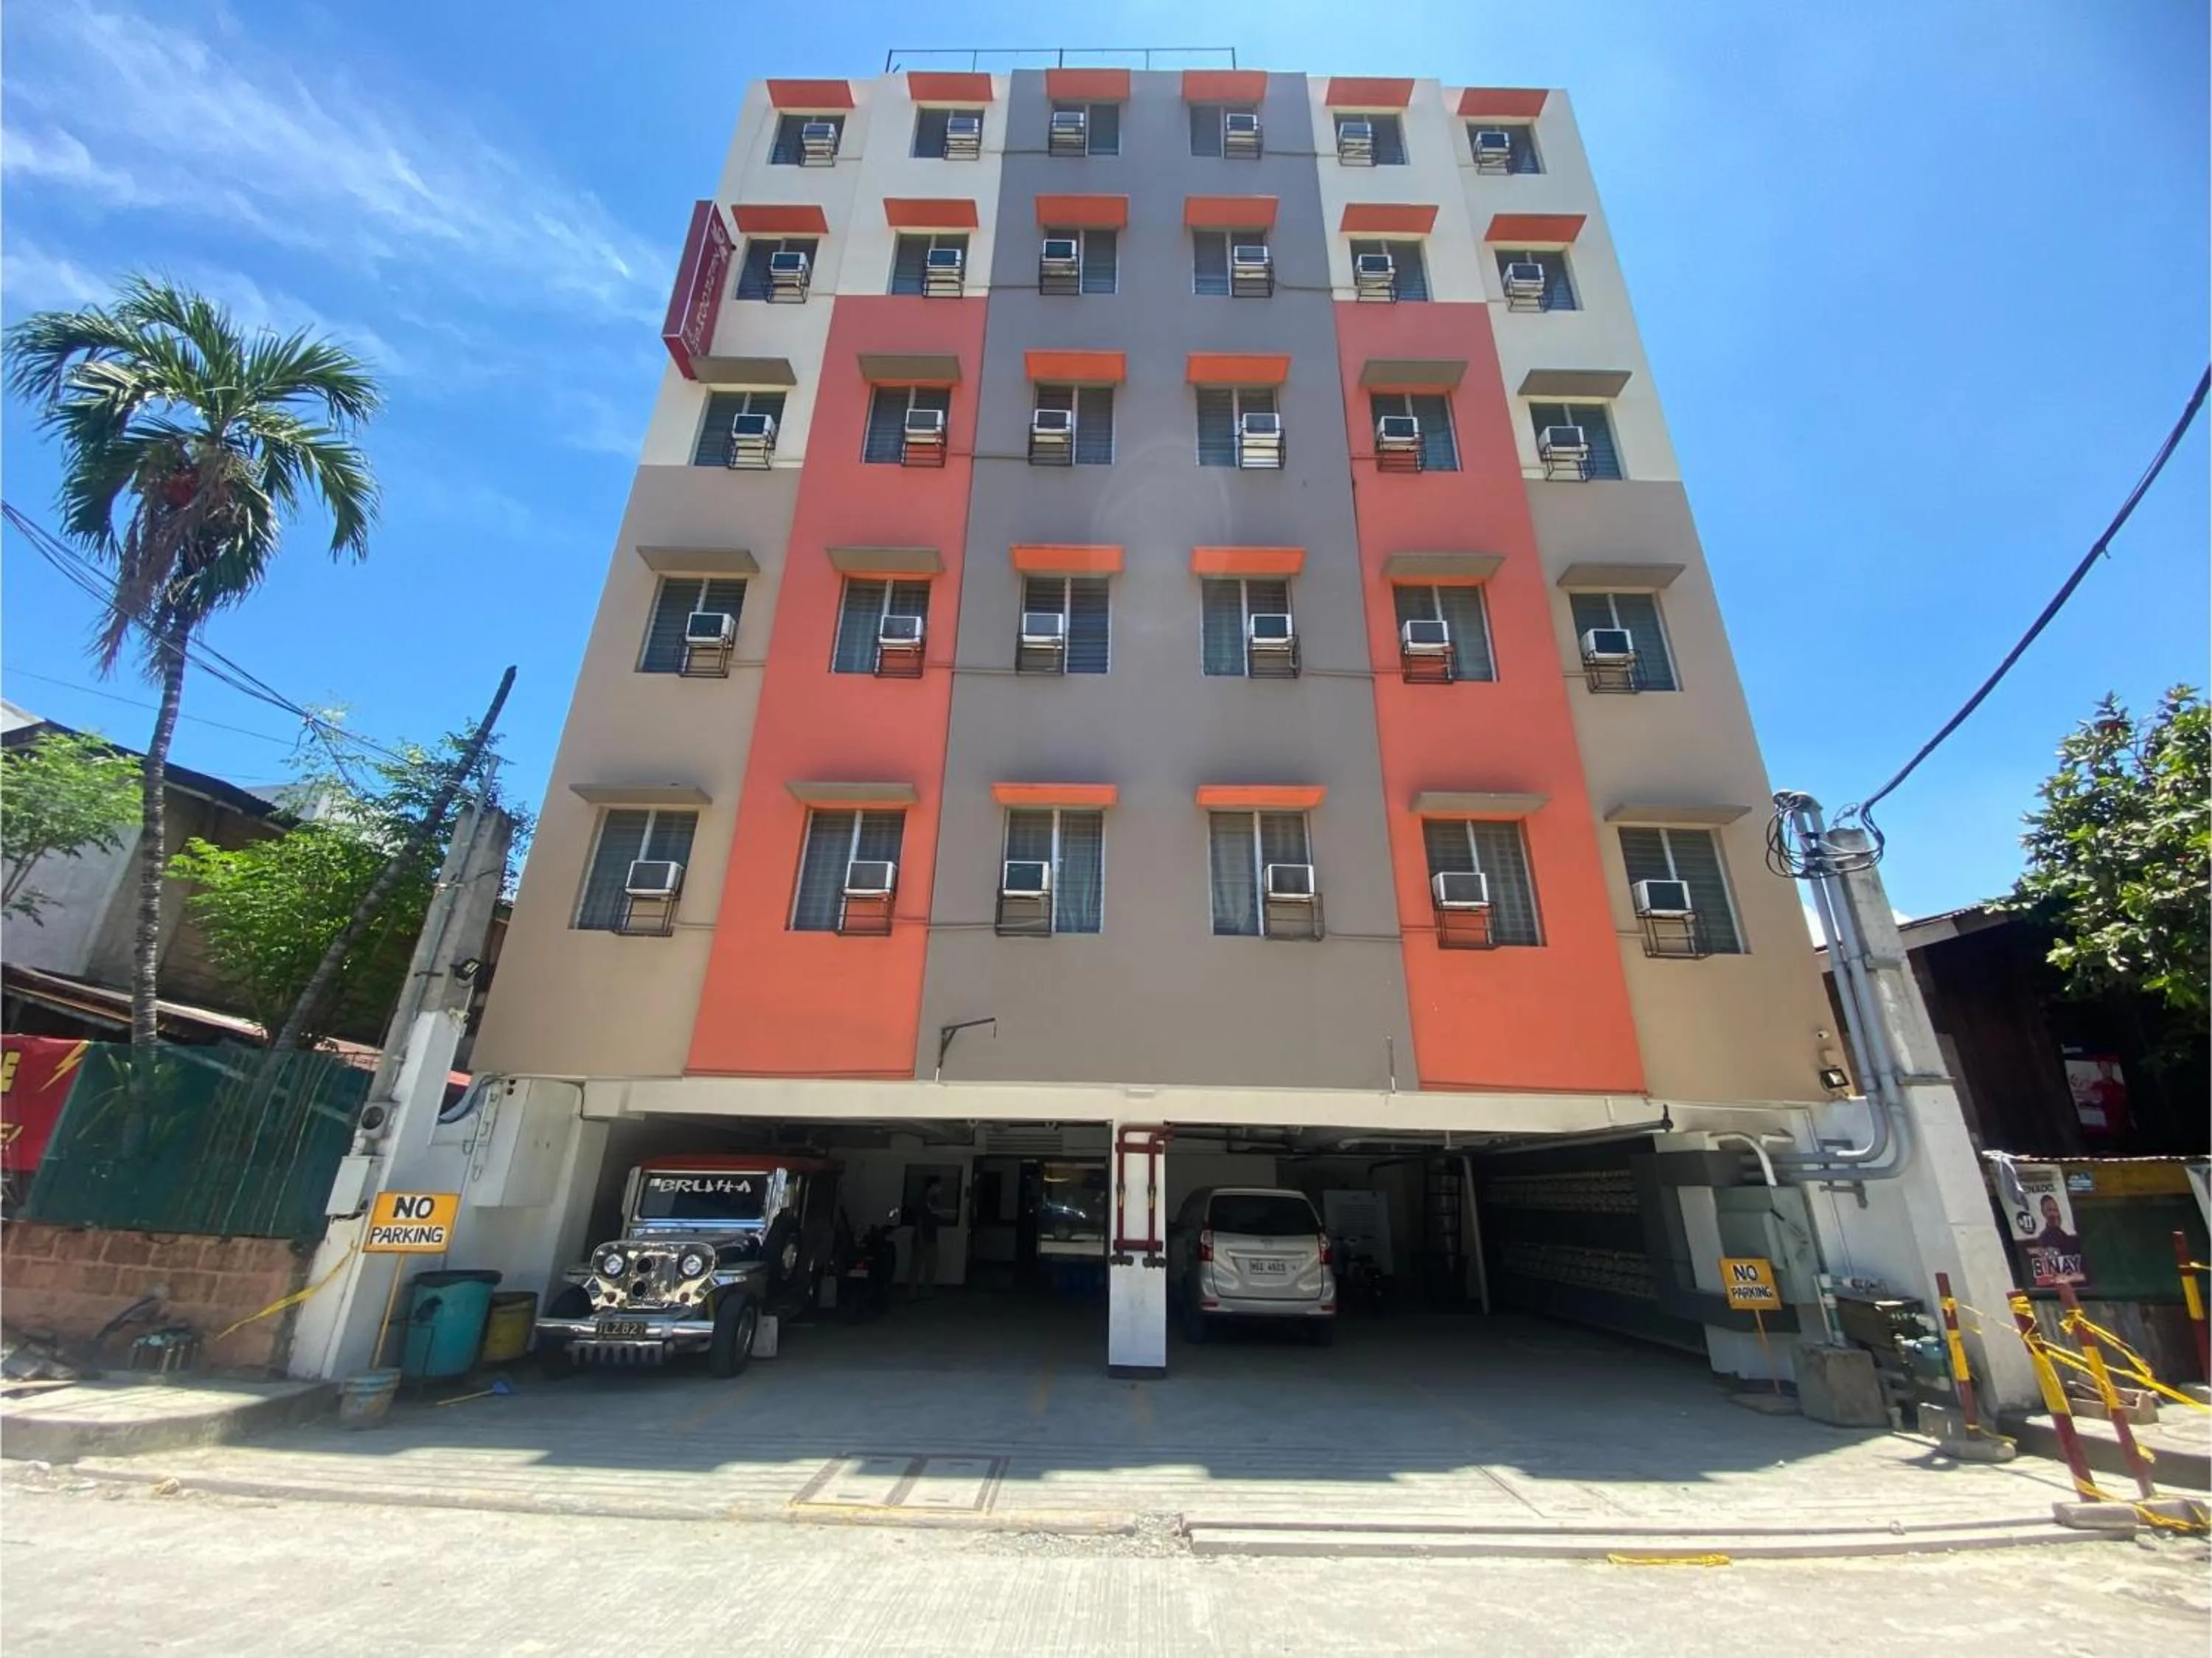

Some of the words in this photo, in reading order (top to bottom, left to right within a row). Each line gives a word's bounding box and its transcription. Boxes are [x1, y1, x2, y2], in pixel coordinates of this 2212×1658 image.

[393, 1196, 435, 1218] NO
[369, 1227, 444, 1245] PARKING
[1733, 1264, 1758, 1281] NO
[2032, 1254, 2081, 1277] BINAY
[1731, 1286, 1773, 1299] PARKING
